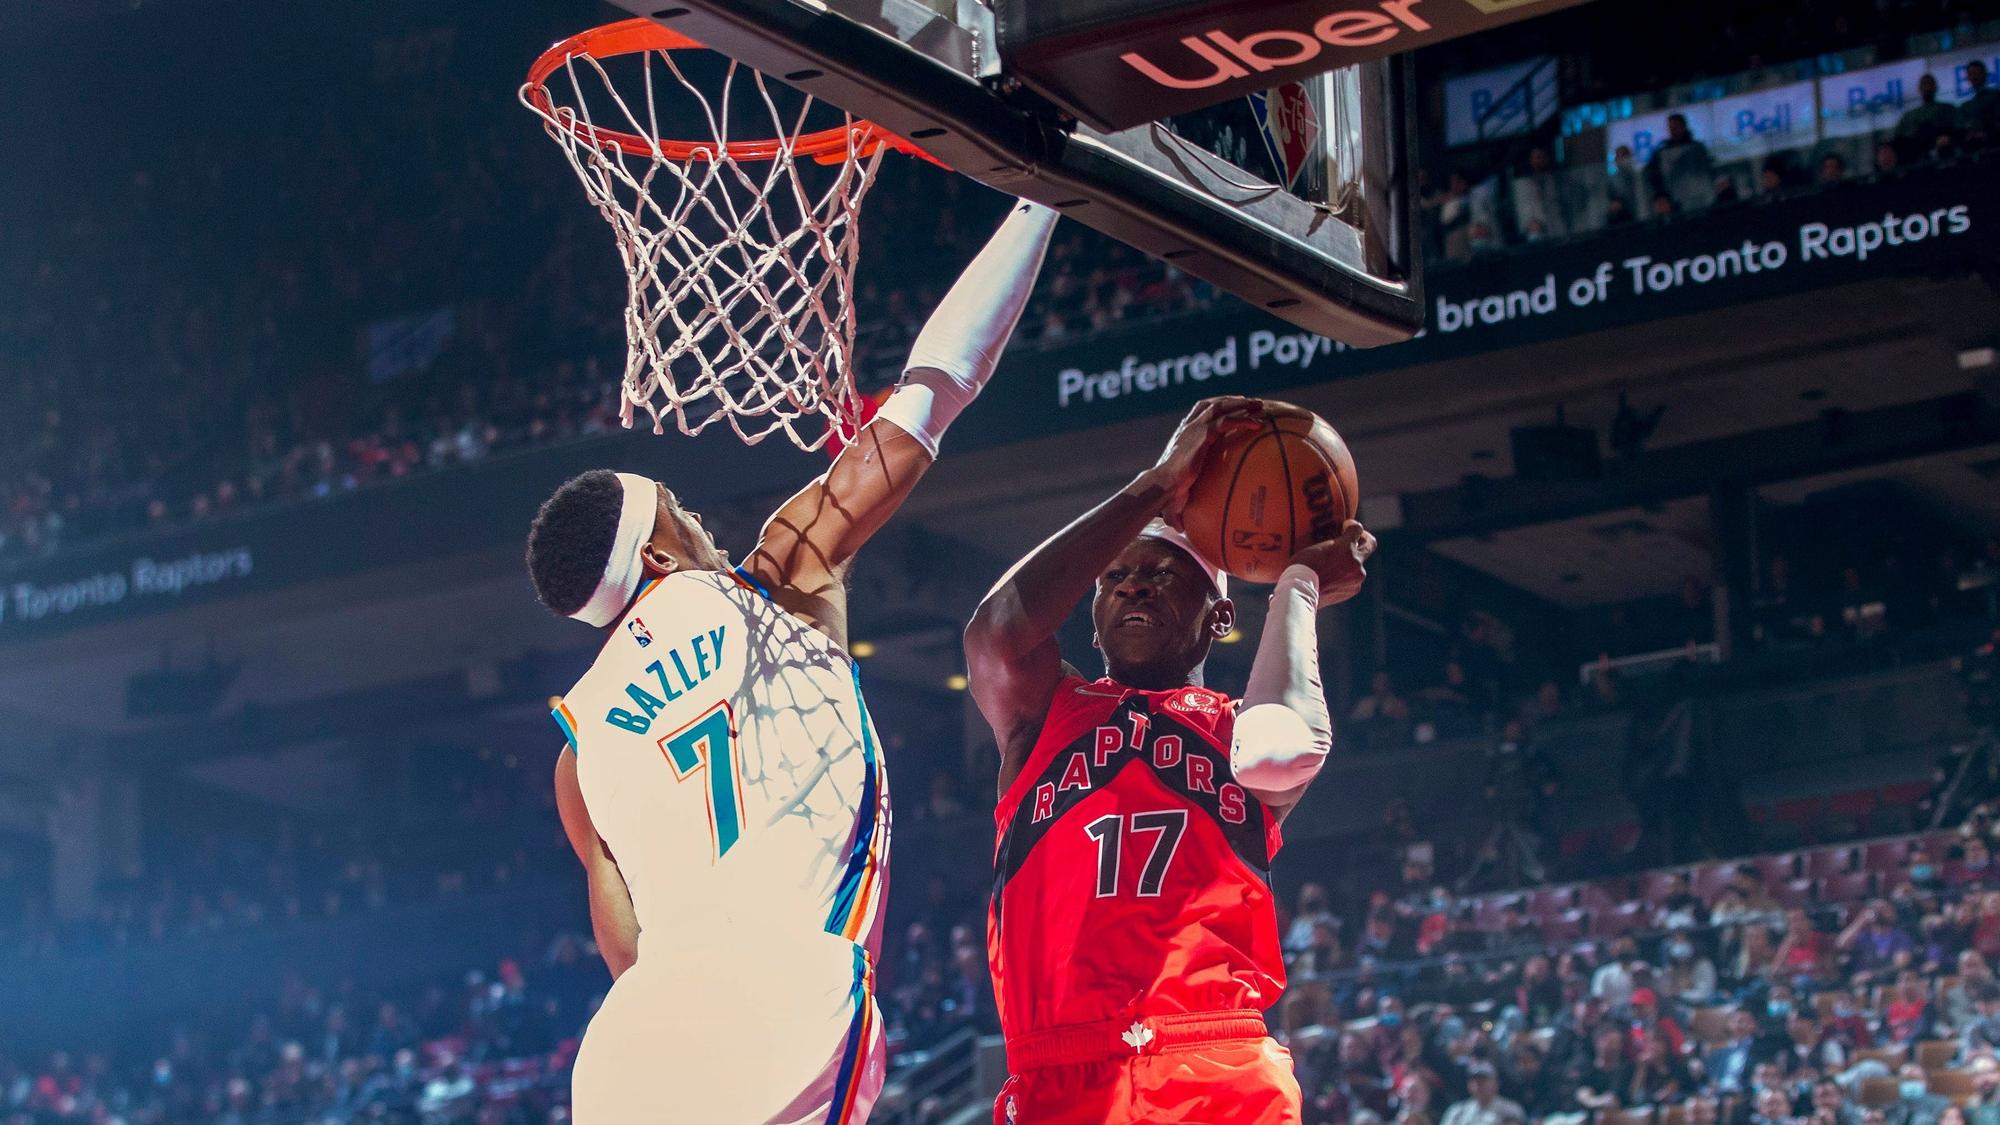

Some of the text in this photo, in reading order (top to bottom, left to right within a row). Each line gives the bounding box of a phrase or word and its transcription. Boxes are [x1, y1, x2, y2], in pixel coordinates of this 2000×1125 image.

[1119, 0, 1433, 89] Uber
[1736, 102, 1792, 137] Bell
[1058, 336, 1237, 407] Preferred
[1436, 273, 1556, 333] brand
[1568, 261, 1614, 307] of
[1622, 239, 1788, 295] Toronto
[1799, 204, 1972, 262] Raptors
[13, 572, 128, 620] Toronto
[132, 547, 253, 596] Raptors
[605, 625, 726, 736] BAZLEY
[657, 698, 747, 867] 7
[1031, 710, 1247, 825] RAPTORS
[1083, 808, 1189, 899] 17
